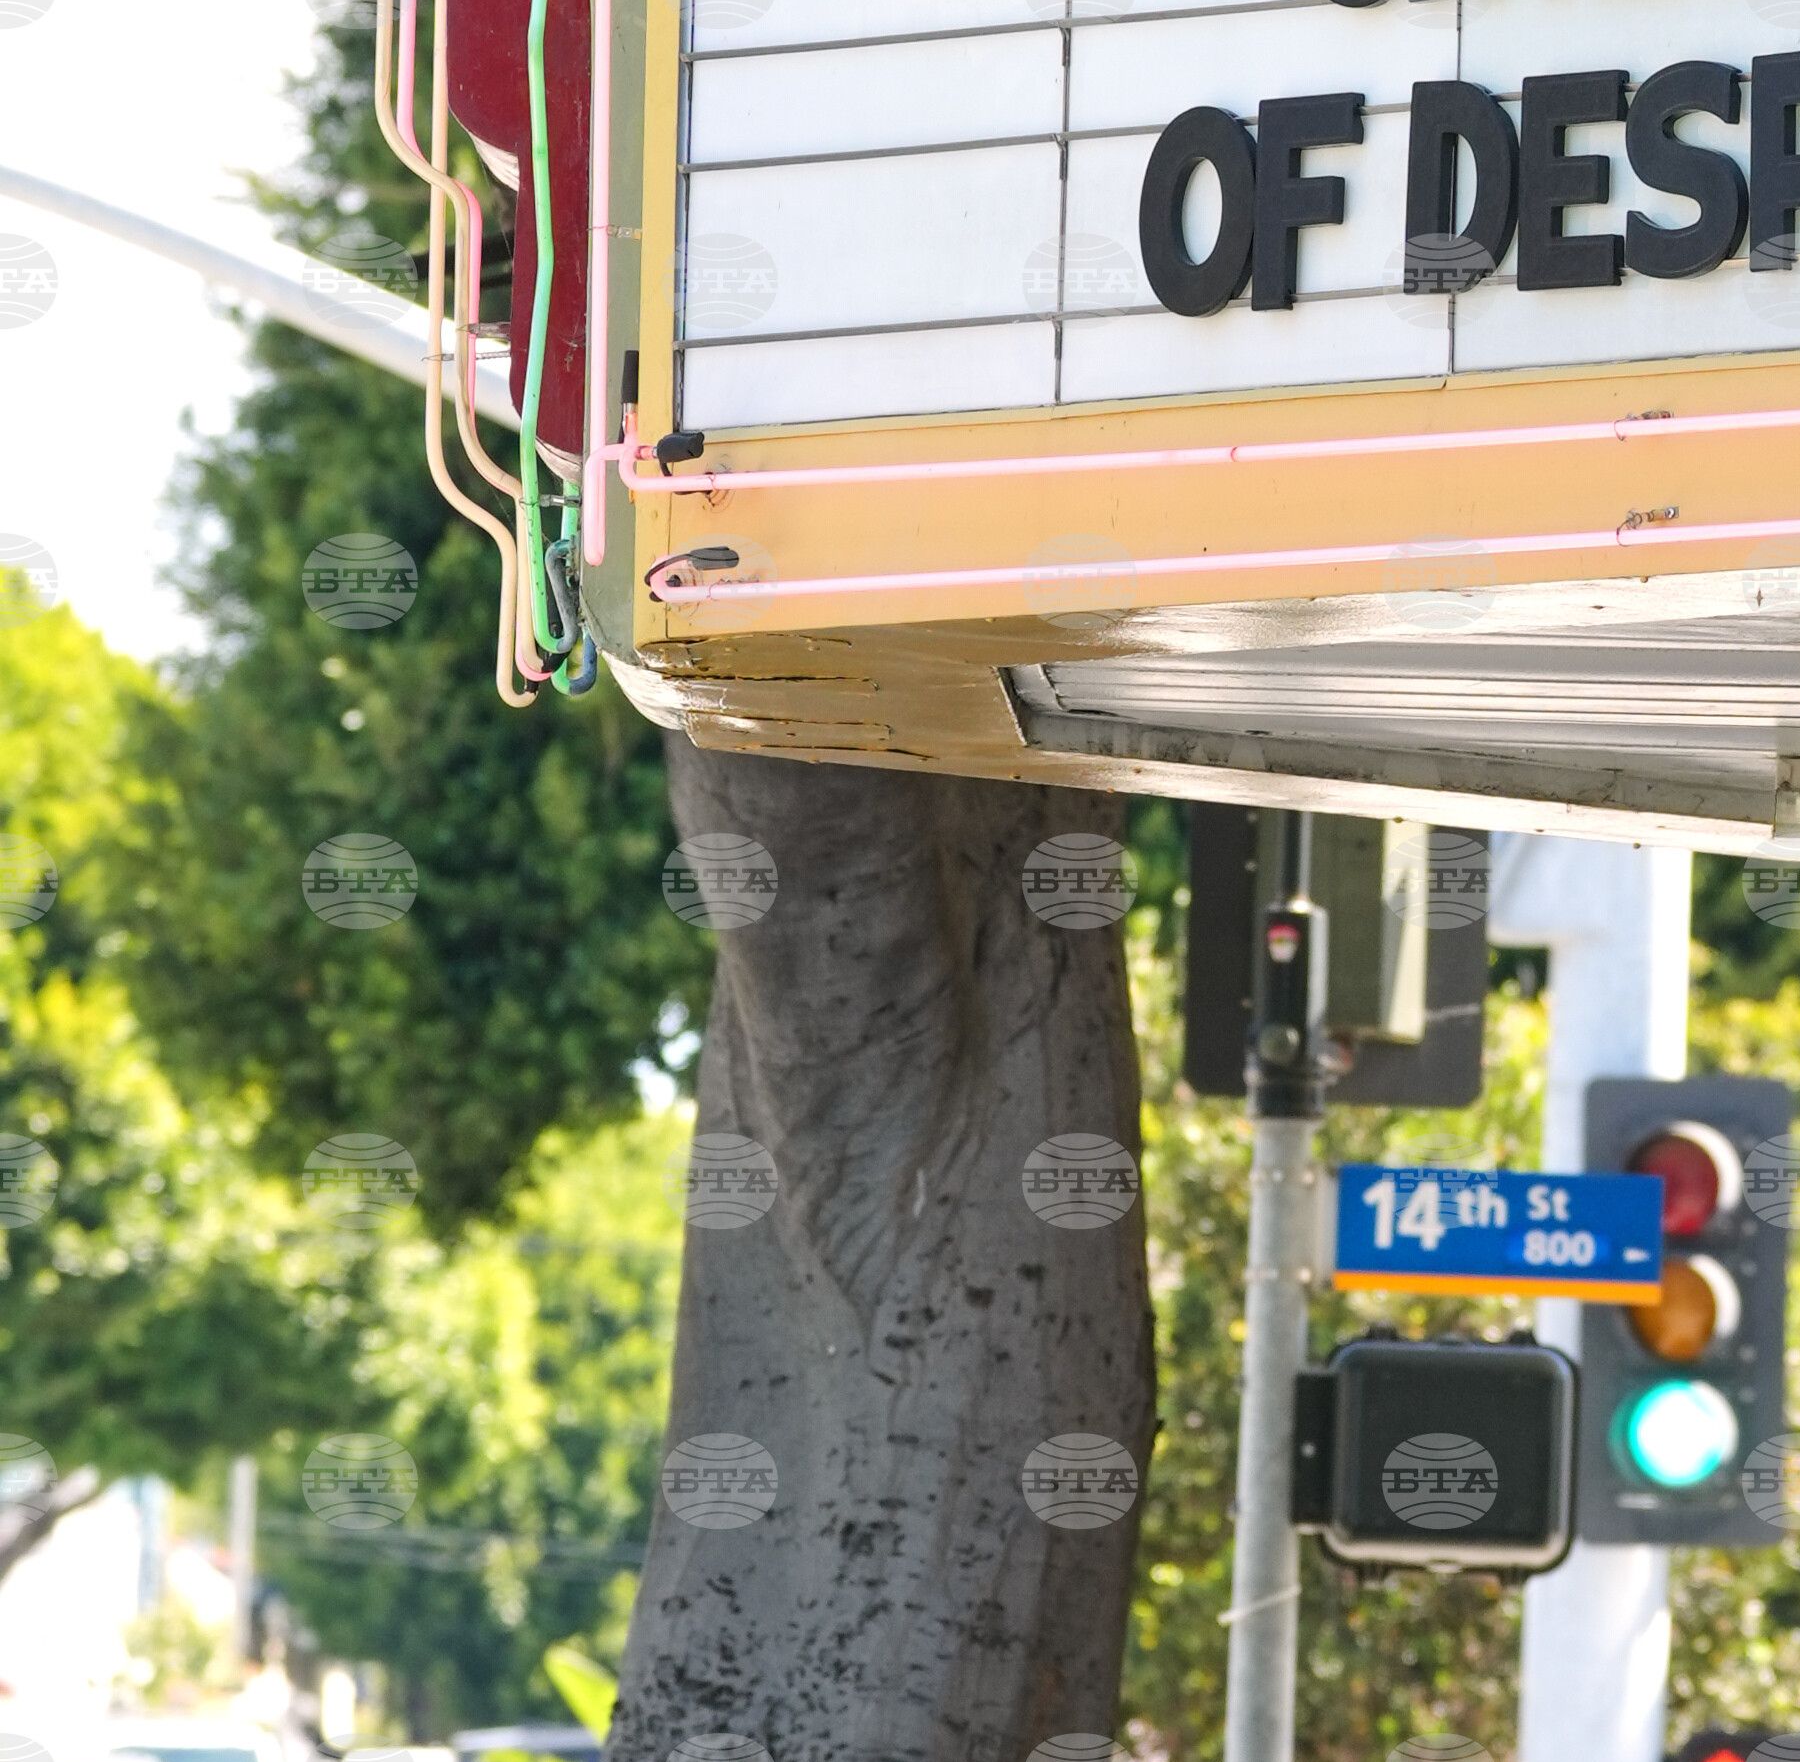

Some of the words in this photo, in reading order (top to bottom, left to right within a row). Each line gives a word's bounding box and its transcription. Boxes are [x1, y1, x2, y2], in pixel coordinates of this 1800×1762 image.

[1139, 92, 1365, 318] OF
[1363, 1180, 1508, 1251] 14th
[1526, 1183, 1569, 1222] St
[1523, 1230, 1596, 1266] 800
